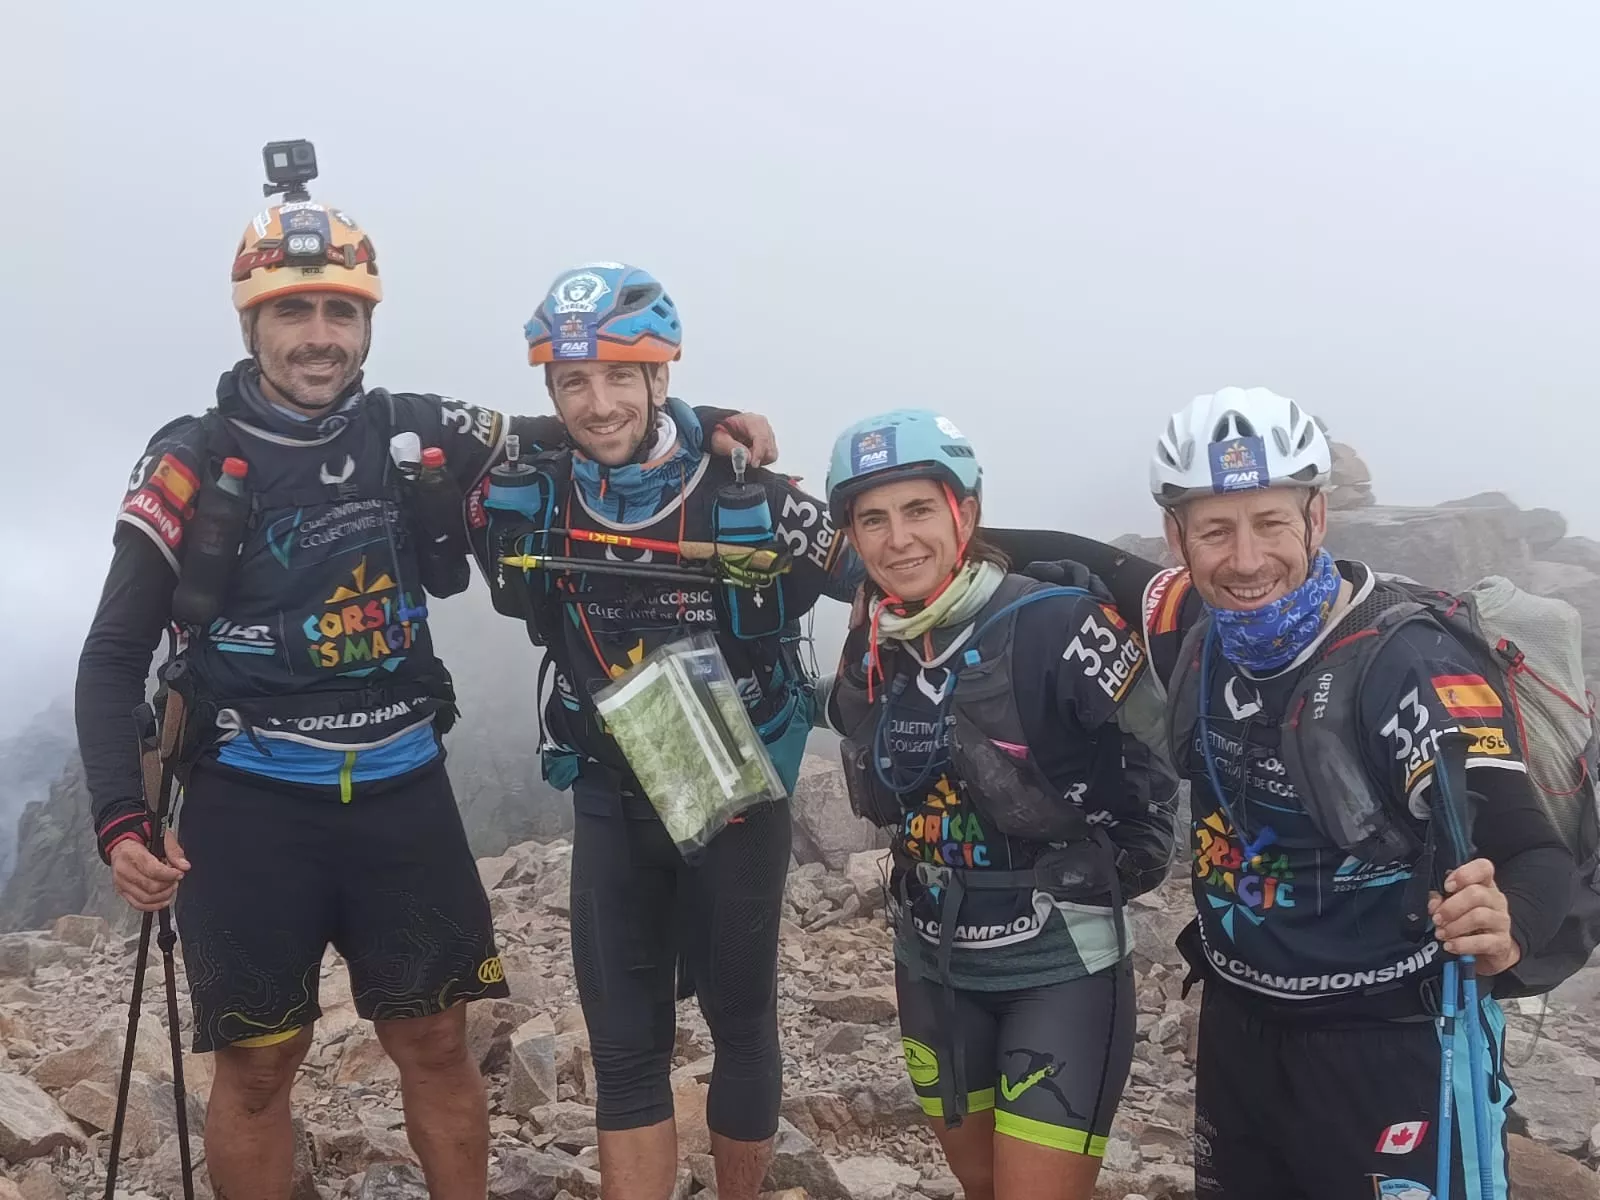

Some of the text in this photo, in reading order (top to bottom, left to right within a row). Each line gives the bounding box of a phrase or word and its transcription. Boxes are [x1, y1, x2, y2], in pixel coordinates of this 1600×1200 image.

[588, 532, 632, 546] LEKI
[775, 493, 818, 557] 33
[660, 590, 713, 605] CORSIC
[676, 608, 717, 622] ORS
[1062, 614, 1118, 677] 33
[1098, 639, 1140, 698] Hertz
[1313, 673, 1334, 703] Rab
[1379, 686, 1429, 760] 33
